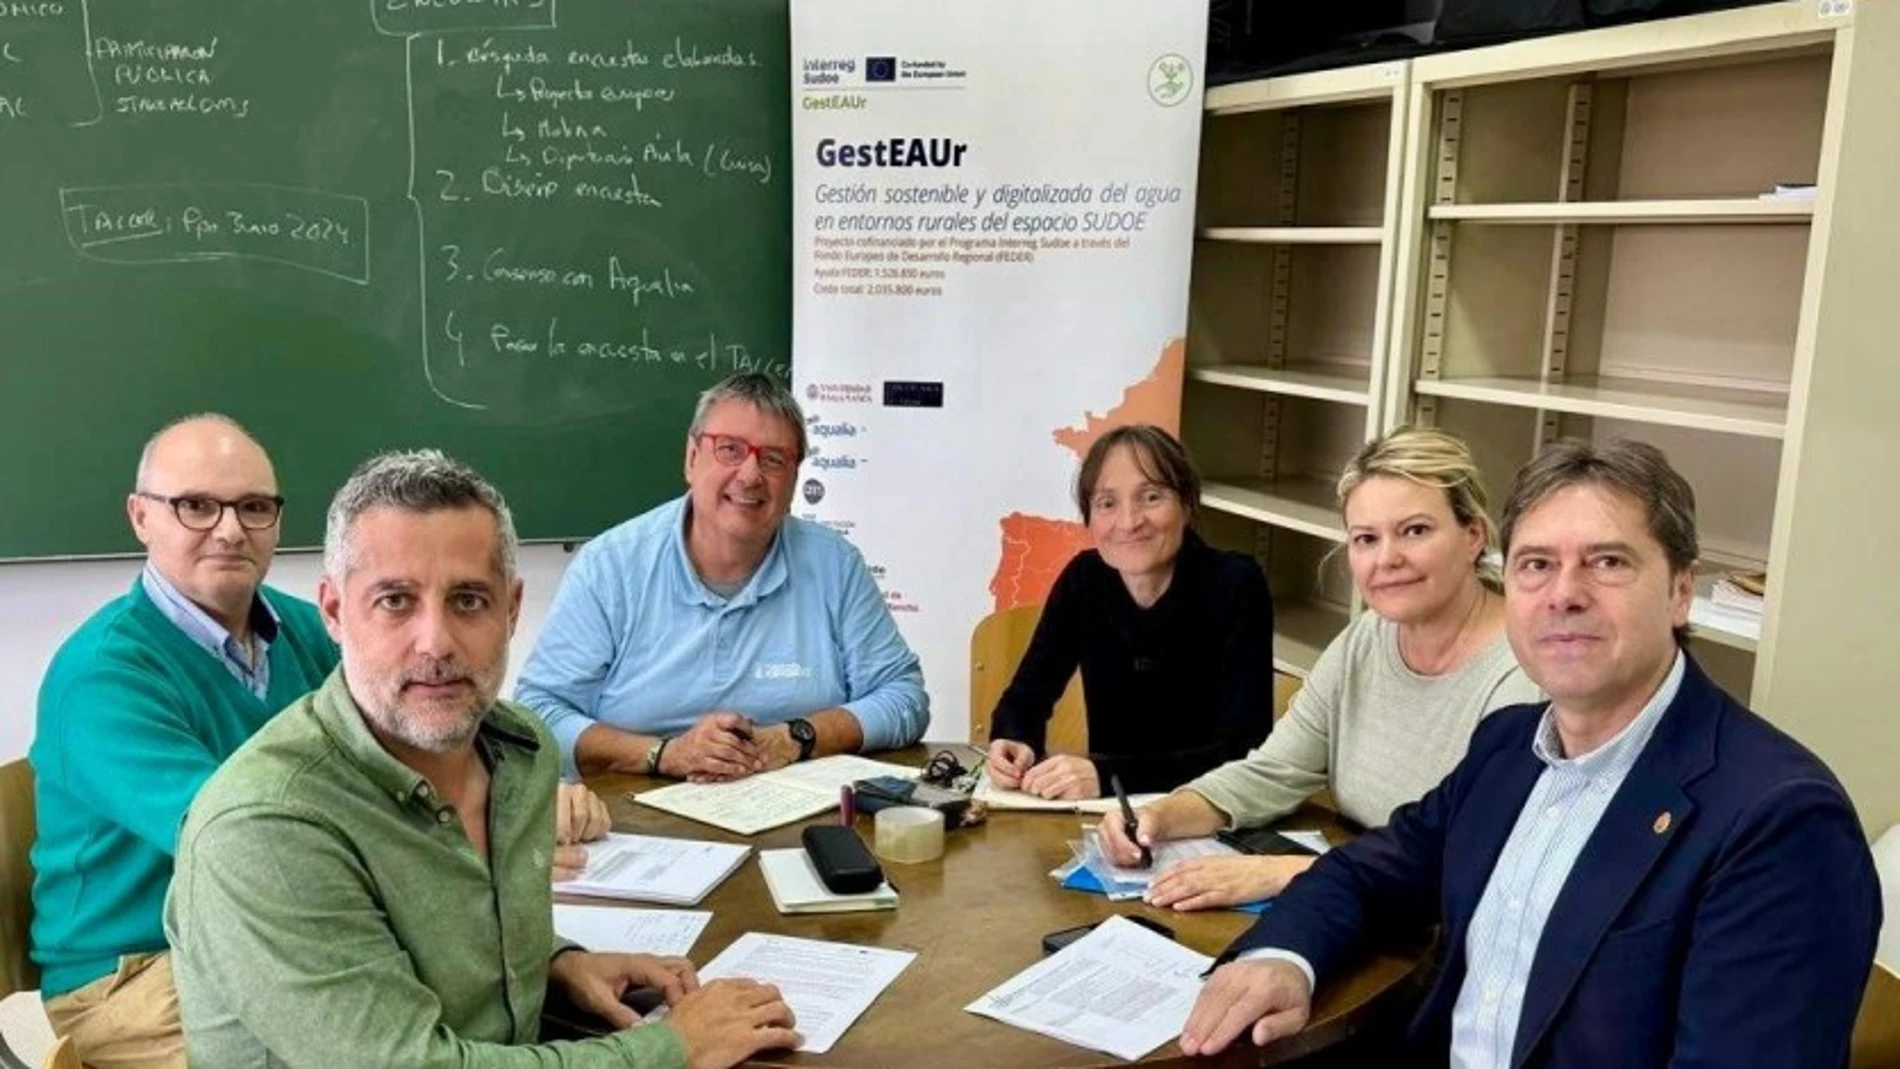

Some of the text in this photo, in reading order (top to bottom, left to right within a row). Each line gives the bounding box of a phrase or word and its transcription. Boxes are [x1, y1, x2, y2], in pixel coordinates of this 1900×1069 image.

[803, 58, 856, 73] Interreg
[803, 72, 840, 85] Sudoe
[802, 95, 867, 110] GestEAUr
[816, 138, 967, 168] GestEAUr
[815, 182, 1181, 210] Gestión sostenible y digitalizada del agua
[285, 212, 349, 245] 2024
[815, 210, 1148, 236] en entornos rurales del espacio SUDOE
[814, 236, 855, 249] Proyecto
[919, 238, 935, 250] por
[938, 236, 947, 248] el
[950, 236, 996, 250] Programa
[999, 236, 1038, 250] Interreg
[1040, 236, 1071, 248] Sudoe
[1114, 236, 1130, 248] del
[886, 251, 899, 262] de
[920, 270, 946, 280] euros
[916, 287, 942, 296] euros
[812, 422, 857, 438] aqualia
[811, 455, 857, 470] aqualia
